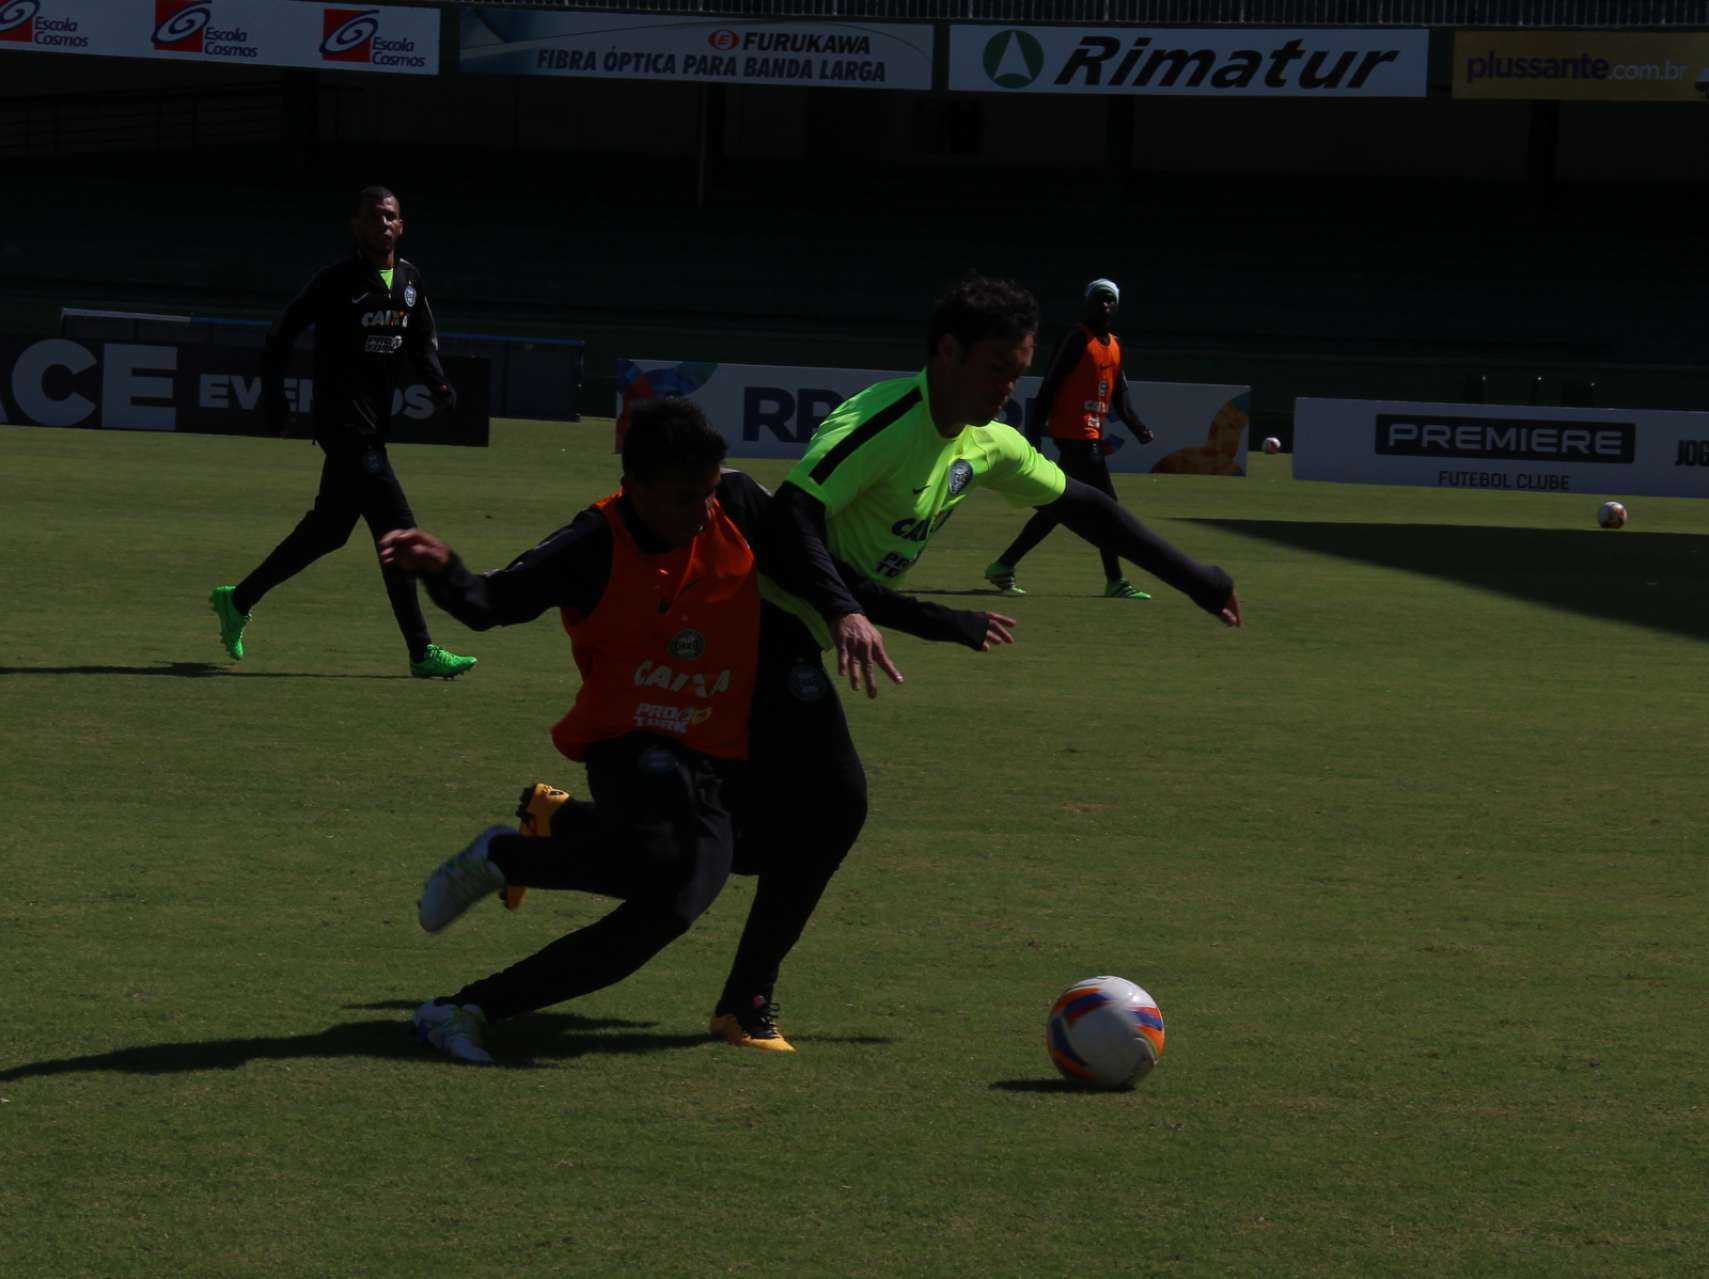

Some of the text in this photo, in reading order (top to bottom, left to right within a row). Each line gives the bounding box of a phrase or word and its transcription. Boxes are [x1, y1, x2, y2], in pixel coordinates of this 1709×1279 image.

[34, 17, 77, 32] Escola
[34, 31, 88, 48] Cosmos
[204, 28, 247, 42] Escola
[372, 37, 415, 52] Escola
[743, 31, 871, 55] FURUKAWA
[204, 42, 258, 58] Cosmos
[372, 51, 425, 68] Cosmos
[537, 46, 886, 82] FIBRA ÓPTICA PARA BANDA LARGA
[1054, 36, 1399, 89] Rimatur
[0, 338, 178, 431] CE
[1388, 422, 1623, 455] PREMIERE
[1439, 470, 1570, 491] FUTEBOL CLUBE
